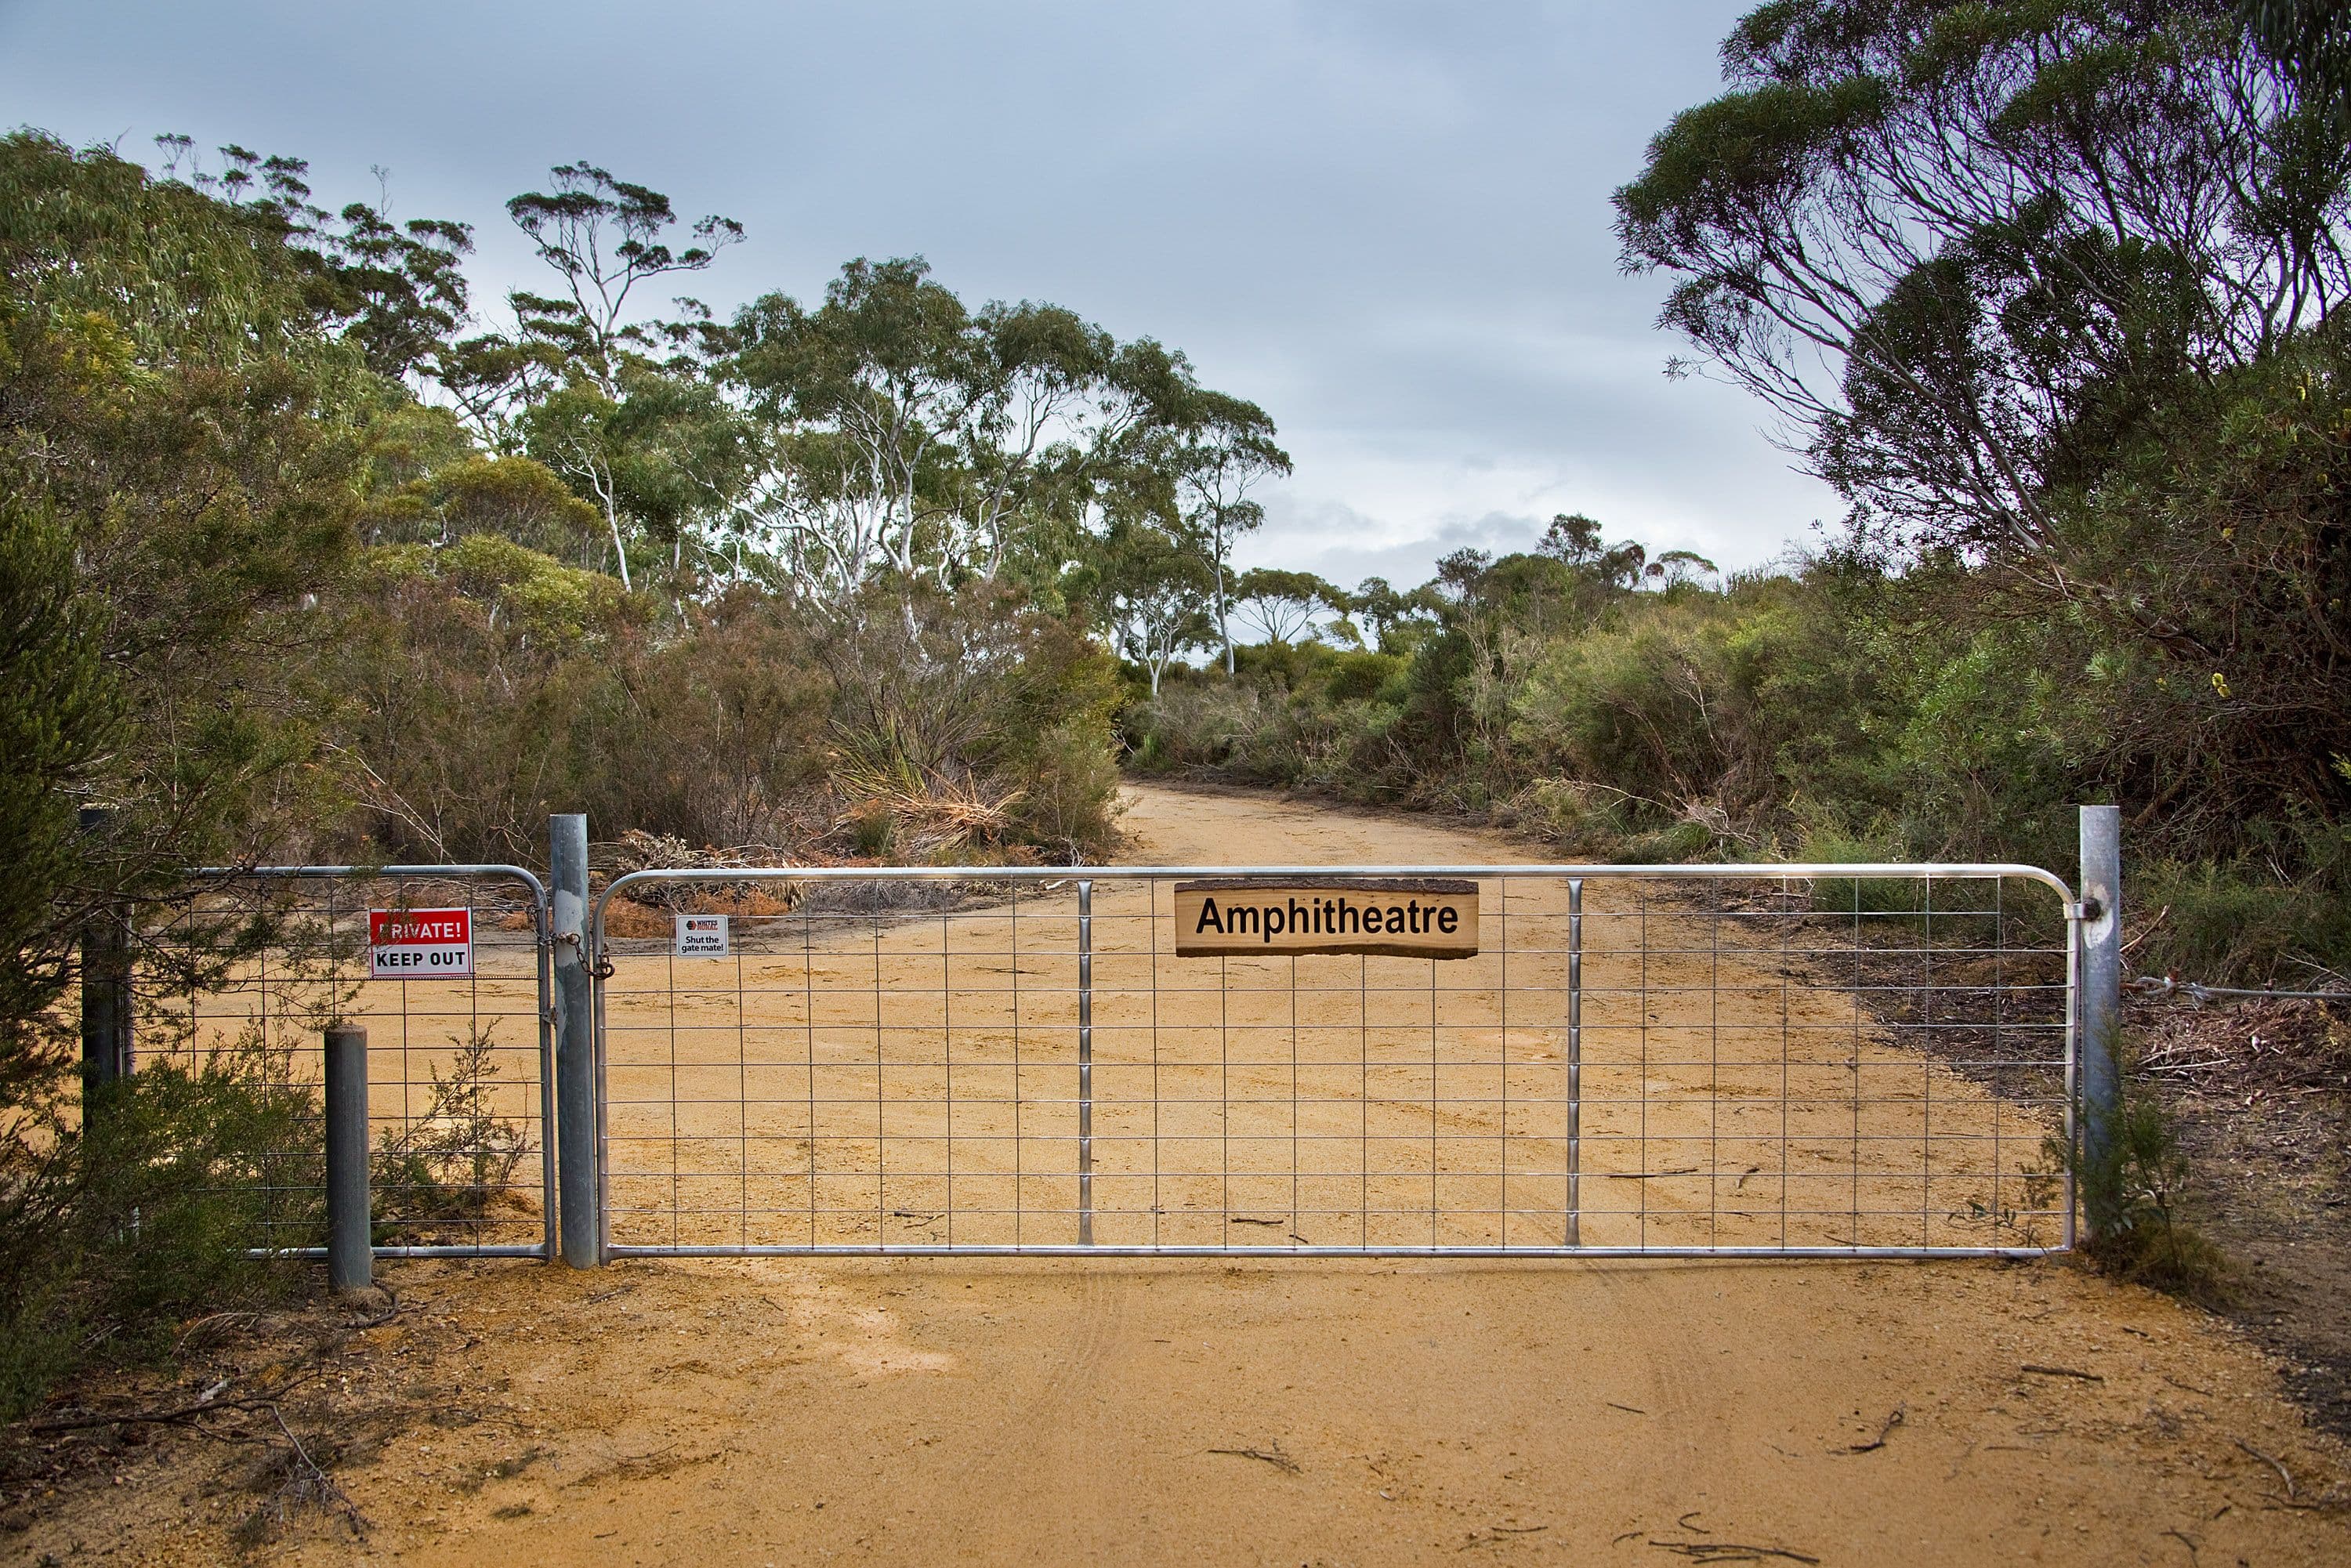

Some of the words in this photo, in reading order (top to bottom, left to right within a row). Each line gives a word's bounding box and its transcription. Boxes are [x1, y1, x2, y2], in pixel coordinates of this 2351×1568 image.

[1196, 897, 1458, 943] Amphitheatre
[681, 944, 700, 954] gate
[376, 952, 423, 966] KEEP
[430, 951, 465, 965] OUT
